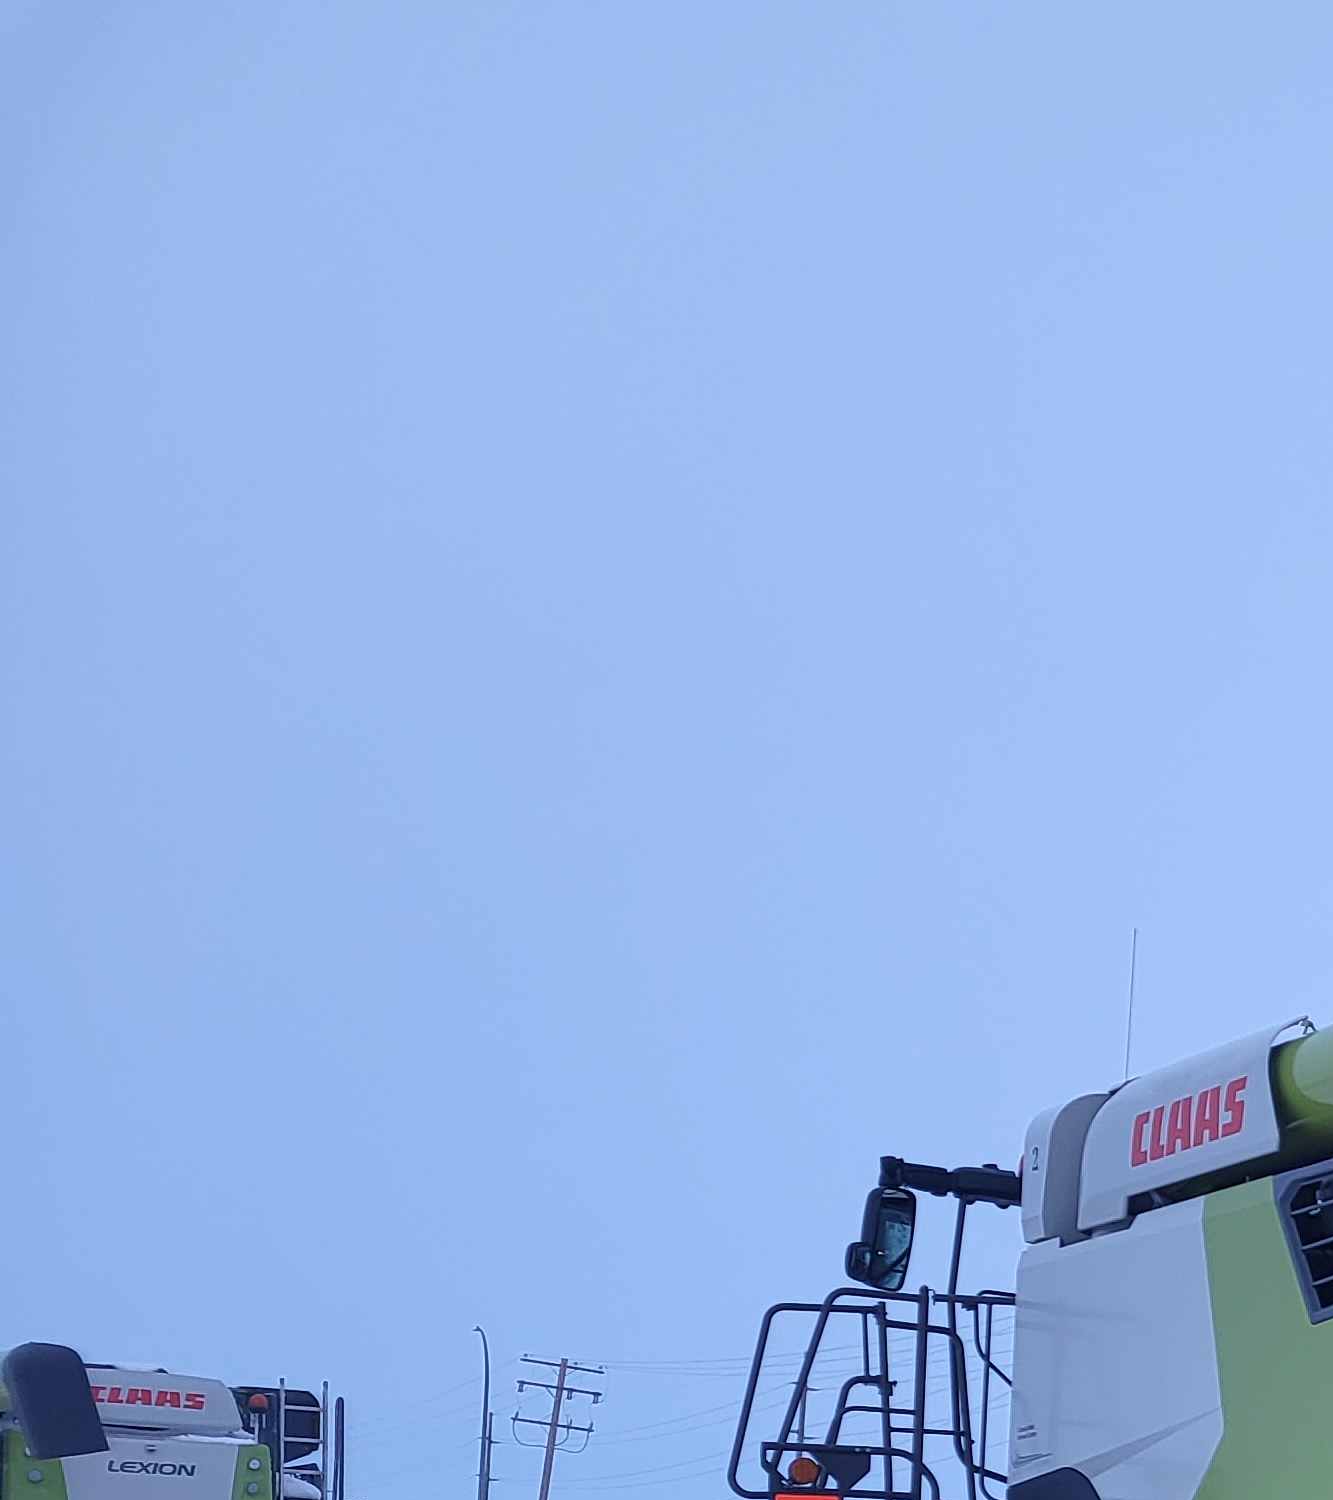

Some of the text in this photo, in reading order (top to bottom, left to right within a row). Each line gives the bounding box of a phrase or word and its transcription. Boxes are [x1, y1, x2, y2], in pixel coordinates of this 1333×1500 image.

[1130, 1075, 1249, 1168] CLAAS
[1031, 1146, 1039, 1172] 2
[90, 1385, 205, 1411] CLAAS
[107, 1460, 197, 1477] LEXION
